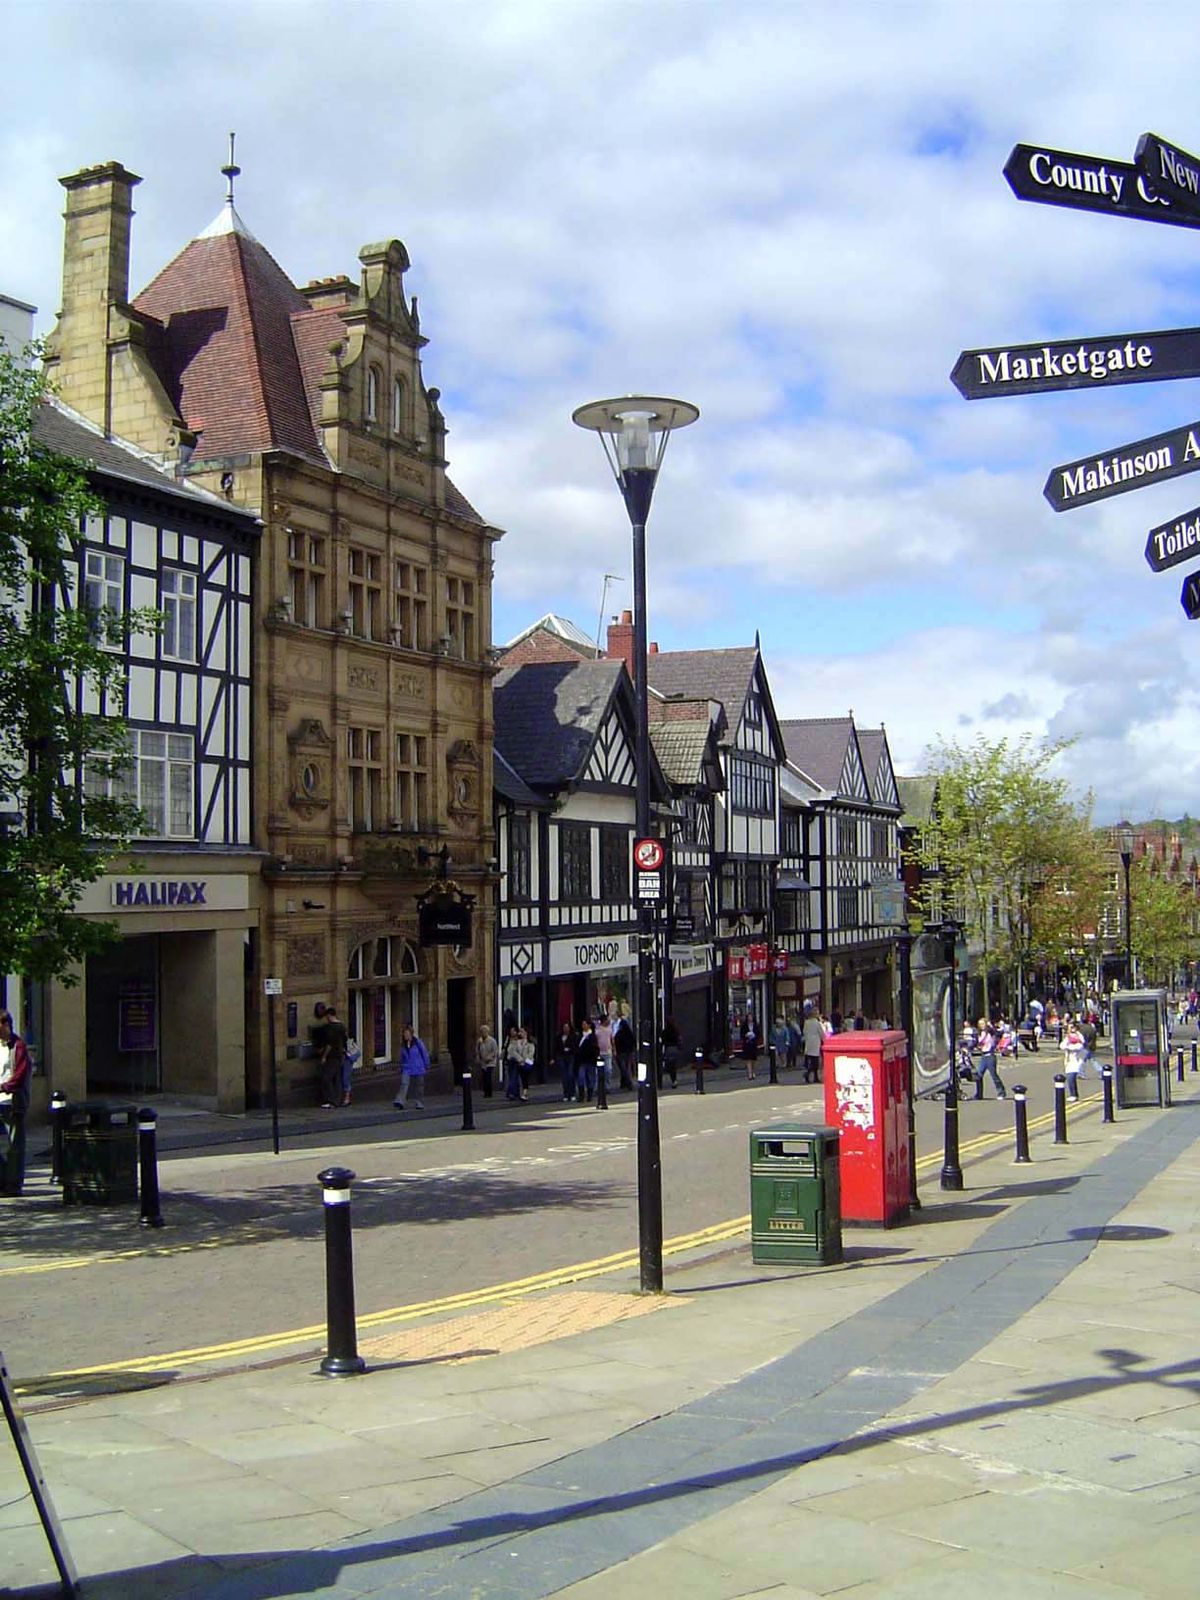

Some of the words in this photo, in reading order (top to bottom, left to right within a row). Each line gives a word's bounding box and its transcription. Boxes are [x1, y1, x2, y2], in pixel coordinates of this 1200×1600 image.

[1028, 153, 1124, 203] County
[1157, 143, 1199, 195] New
[977, 341, 1153, 384] Marketgate
[1061, 446, 1172, 499] Makinson
[115, 881, 207, 906] HALIFAX
[574, 943, 620, 966] TOPSHOP
